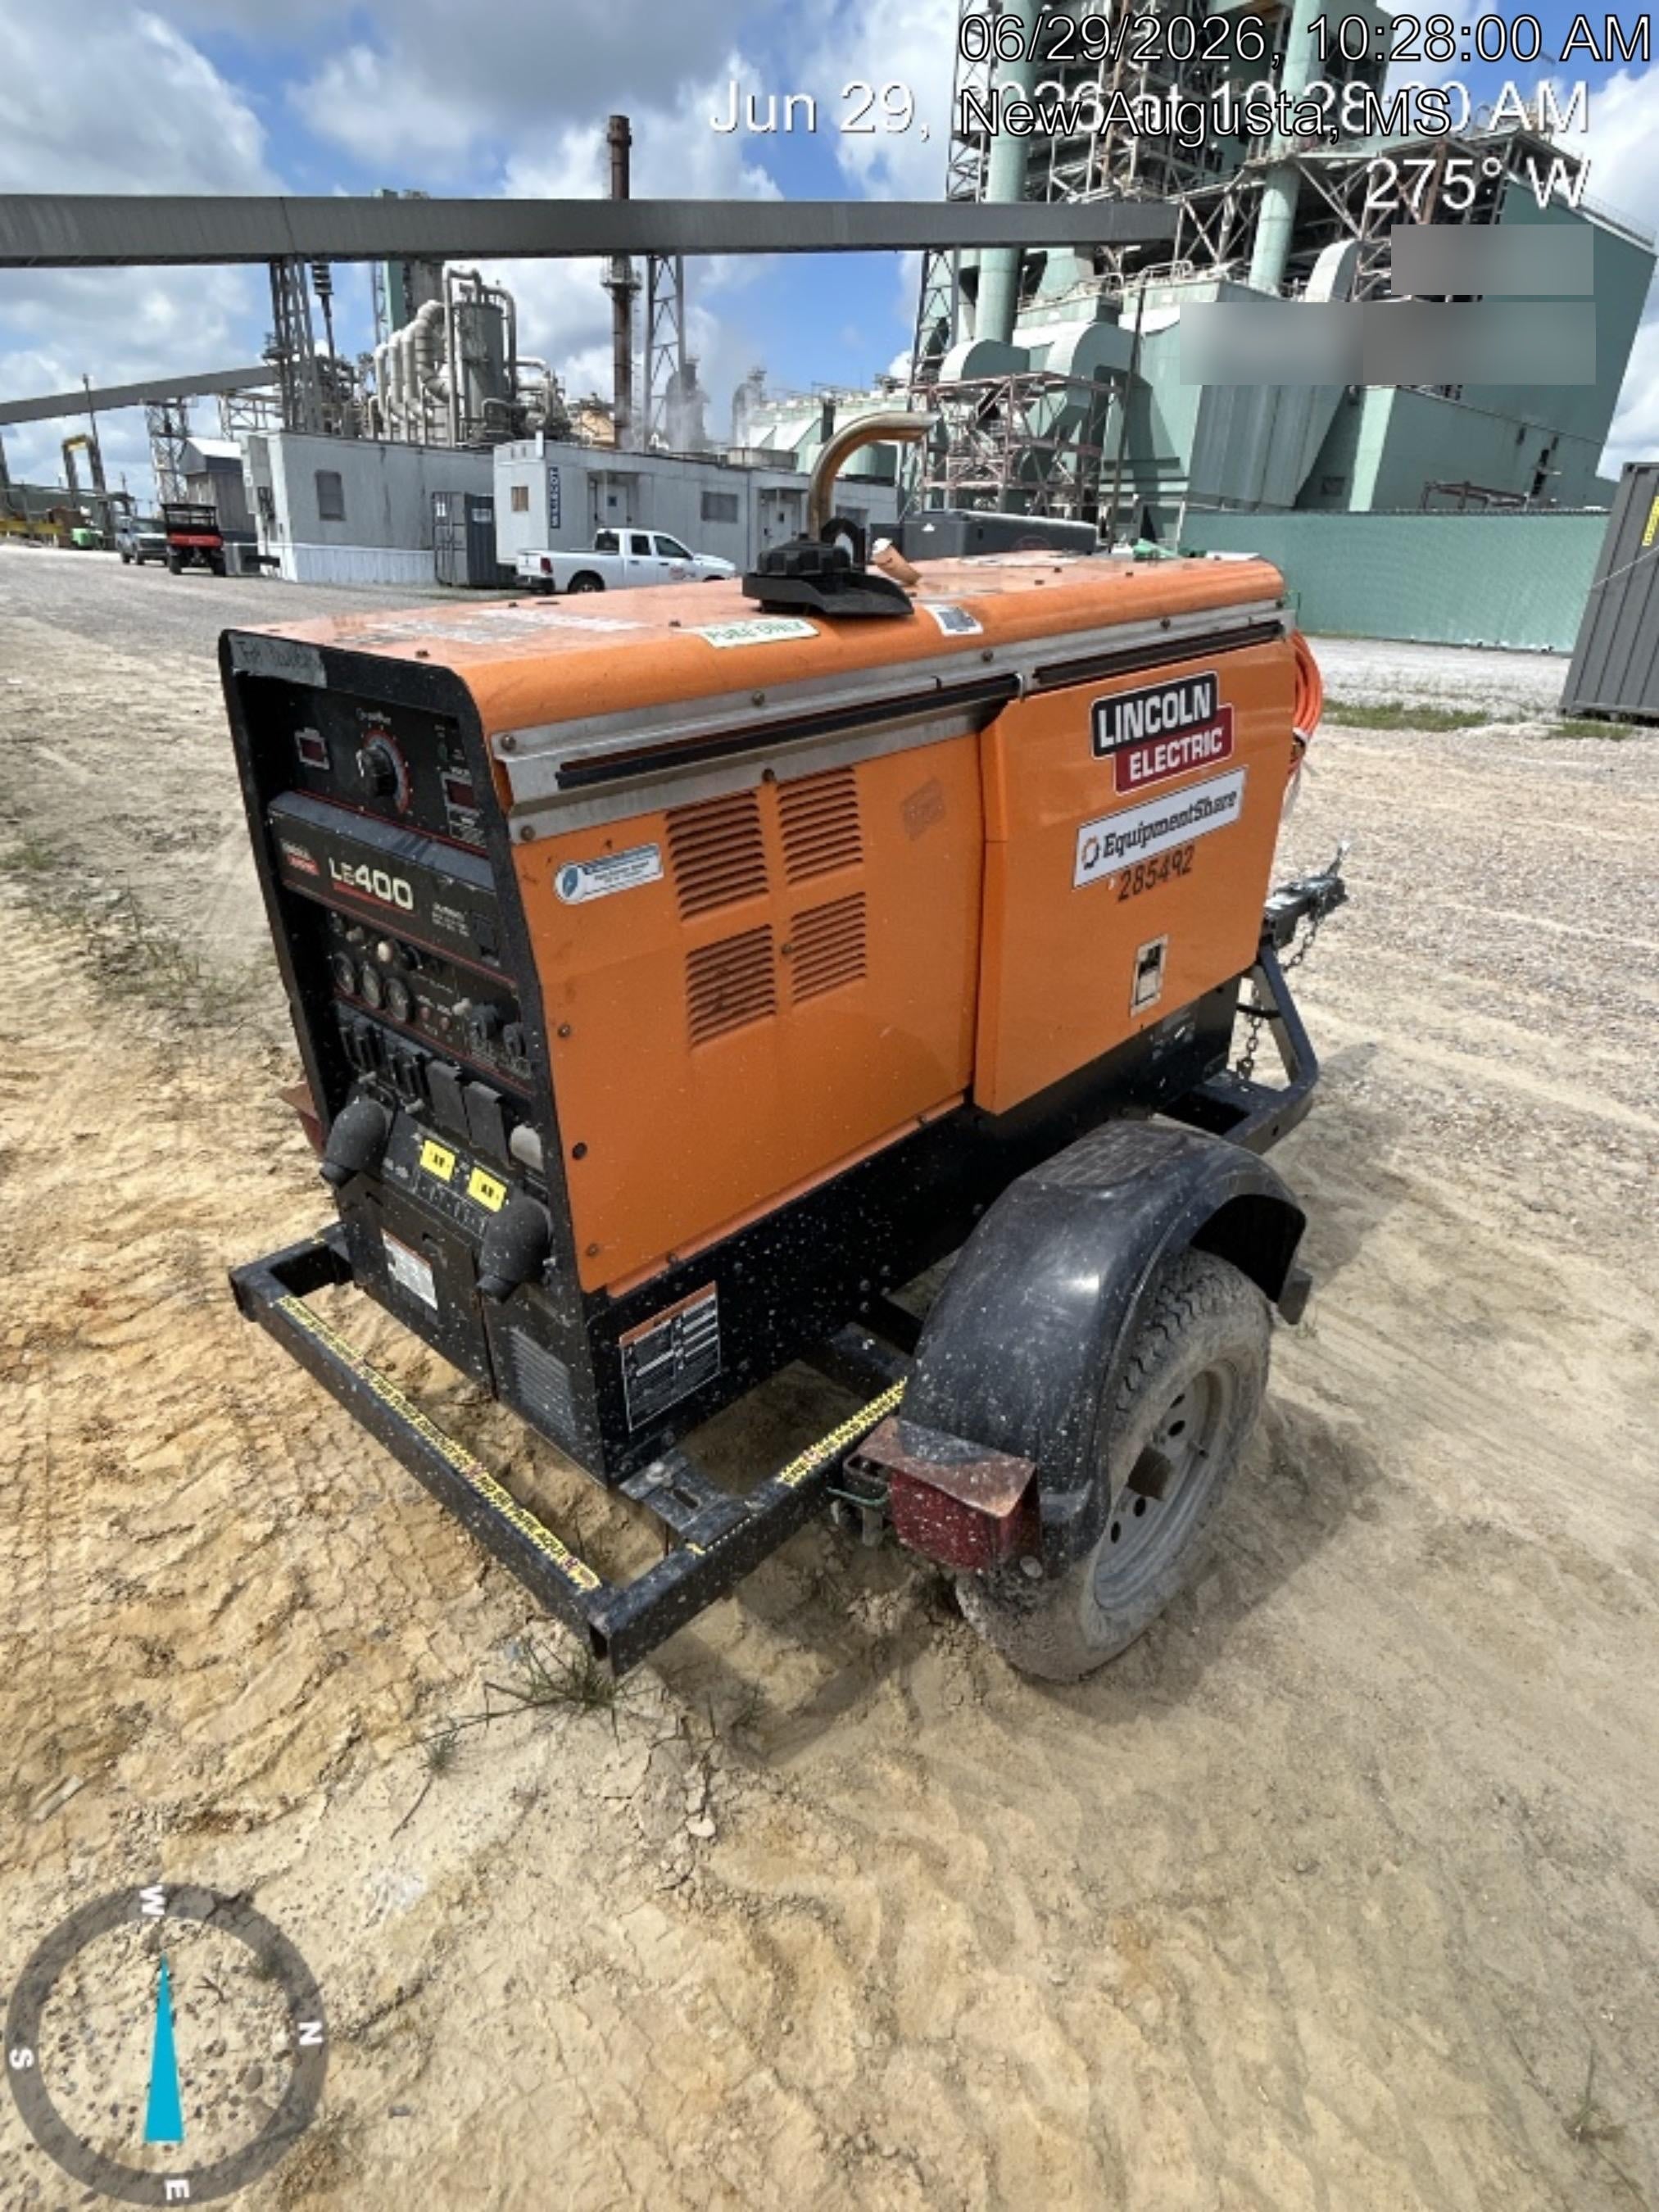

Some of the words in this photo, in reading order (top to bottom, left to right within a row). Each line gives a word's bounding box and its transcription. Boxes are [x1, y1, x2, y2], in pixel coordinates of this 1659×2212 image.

[1098, 682, 1212, 748] LINCOLN
[1129, 727, 1224, 782] ELECTRIC
[1103, 791, 1238, 858] EquipmentShare
[328, 856, 414, 911] LE400
[1117, 845, 1196, 903] 285492
